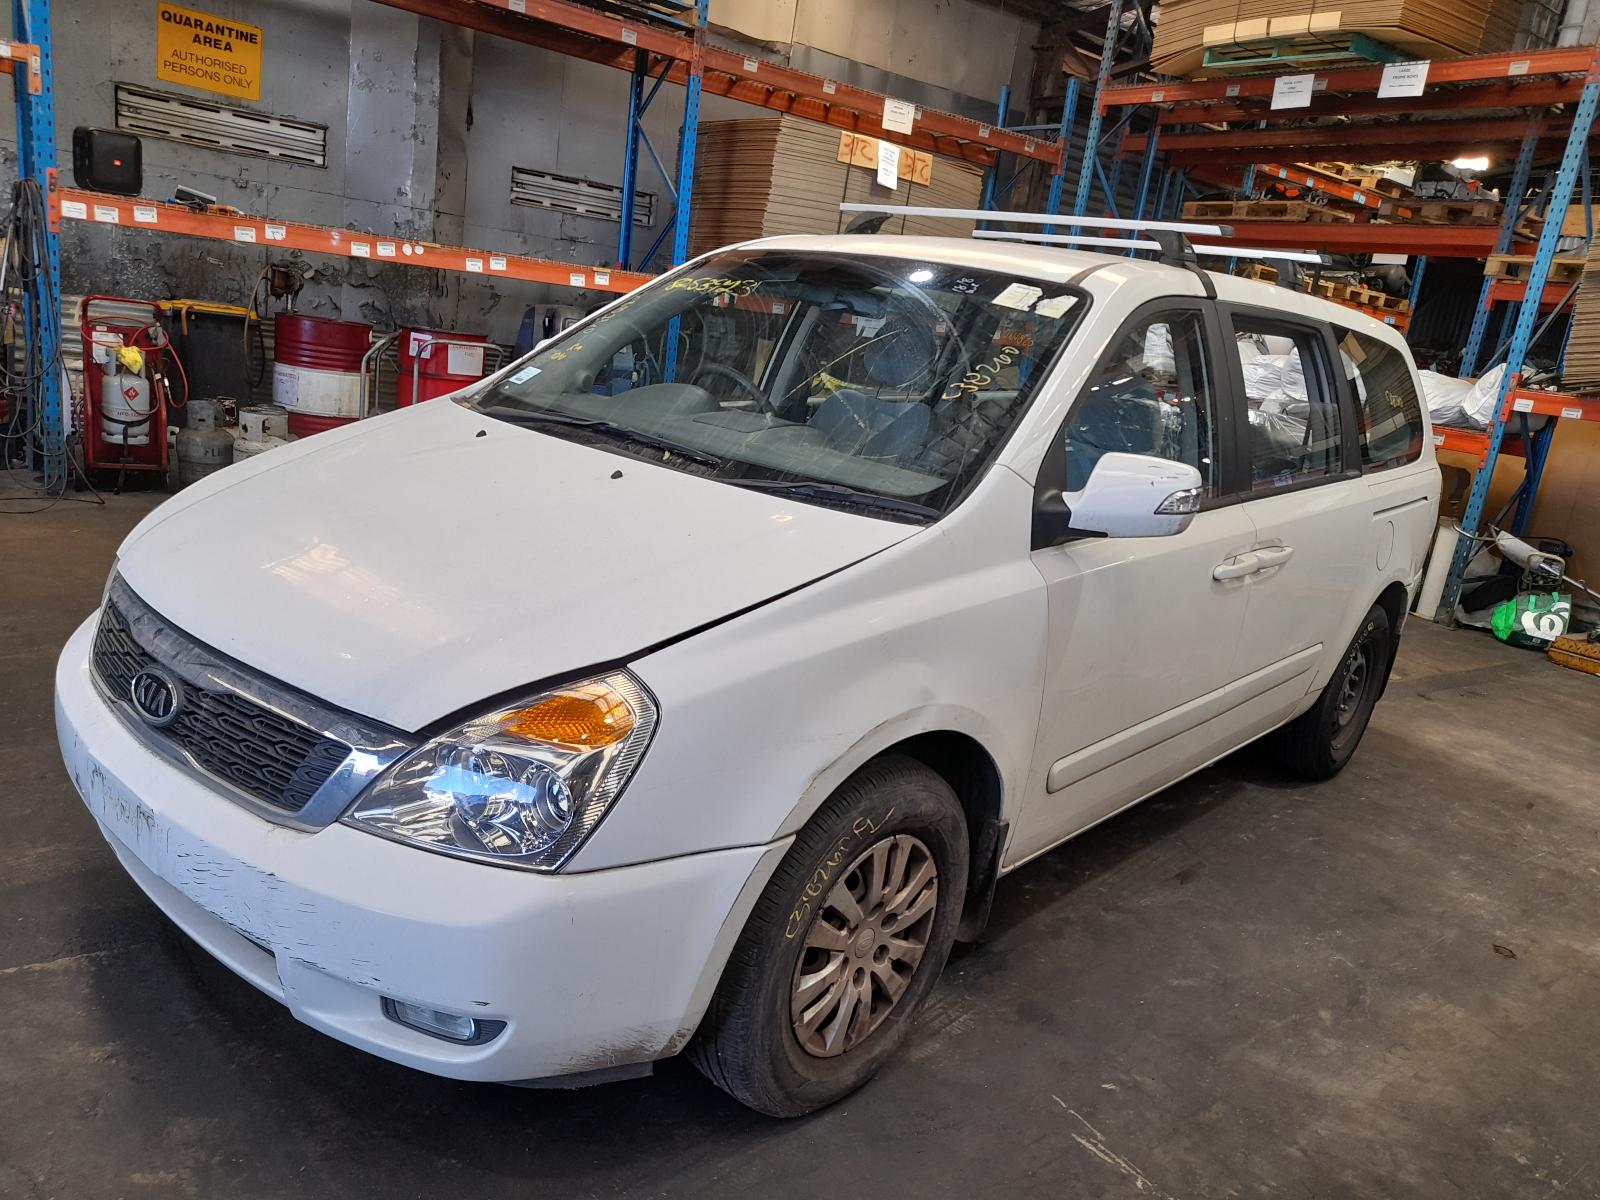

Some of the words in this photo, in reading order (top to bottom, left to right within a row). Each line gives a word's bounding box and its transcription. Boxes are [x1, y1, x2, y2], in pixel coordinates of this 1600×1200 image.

[161, 10, 259, 45] QUARANTINE
[192, 33, 233, 52] AREA
[163, 60, 221, 82] PERSONS
[223, 75, 253, 89] ONLY
[171, 49, 247, 75] AUTHORISED
[136, 674, 167, 716] KIA
